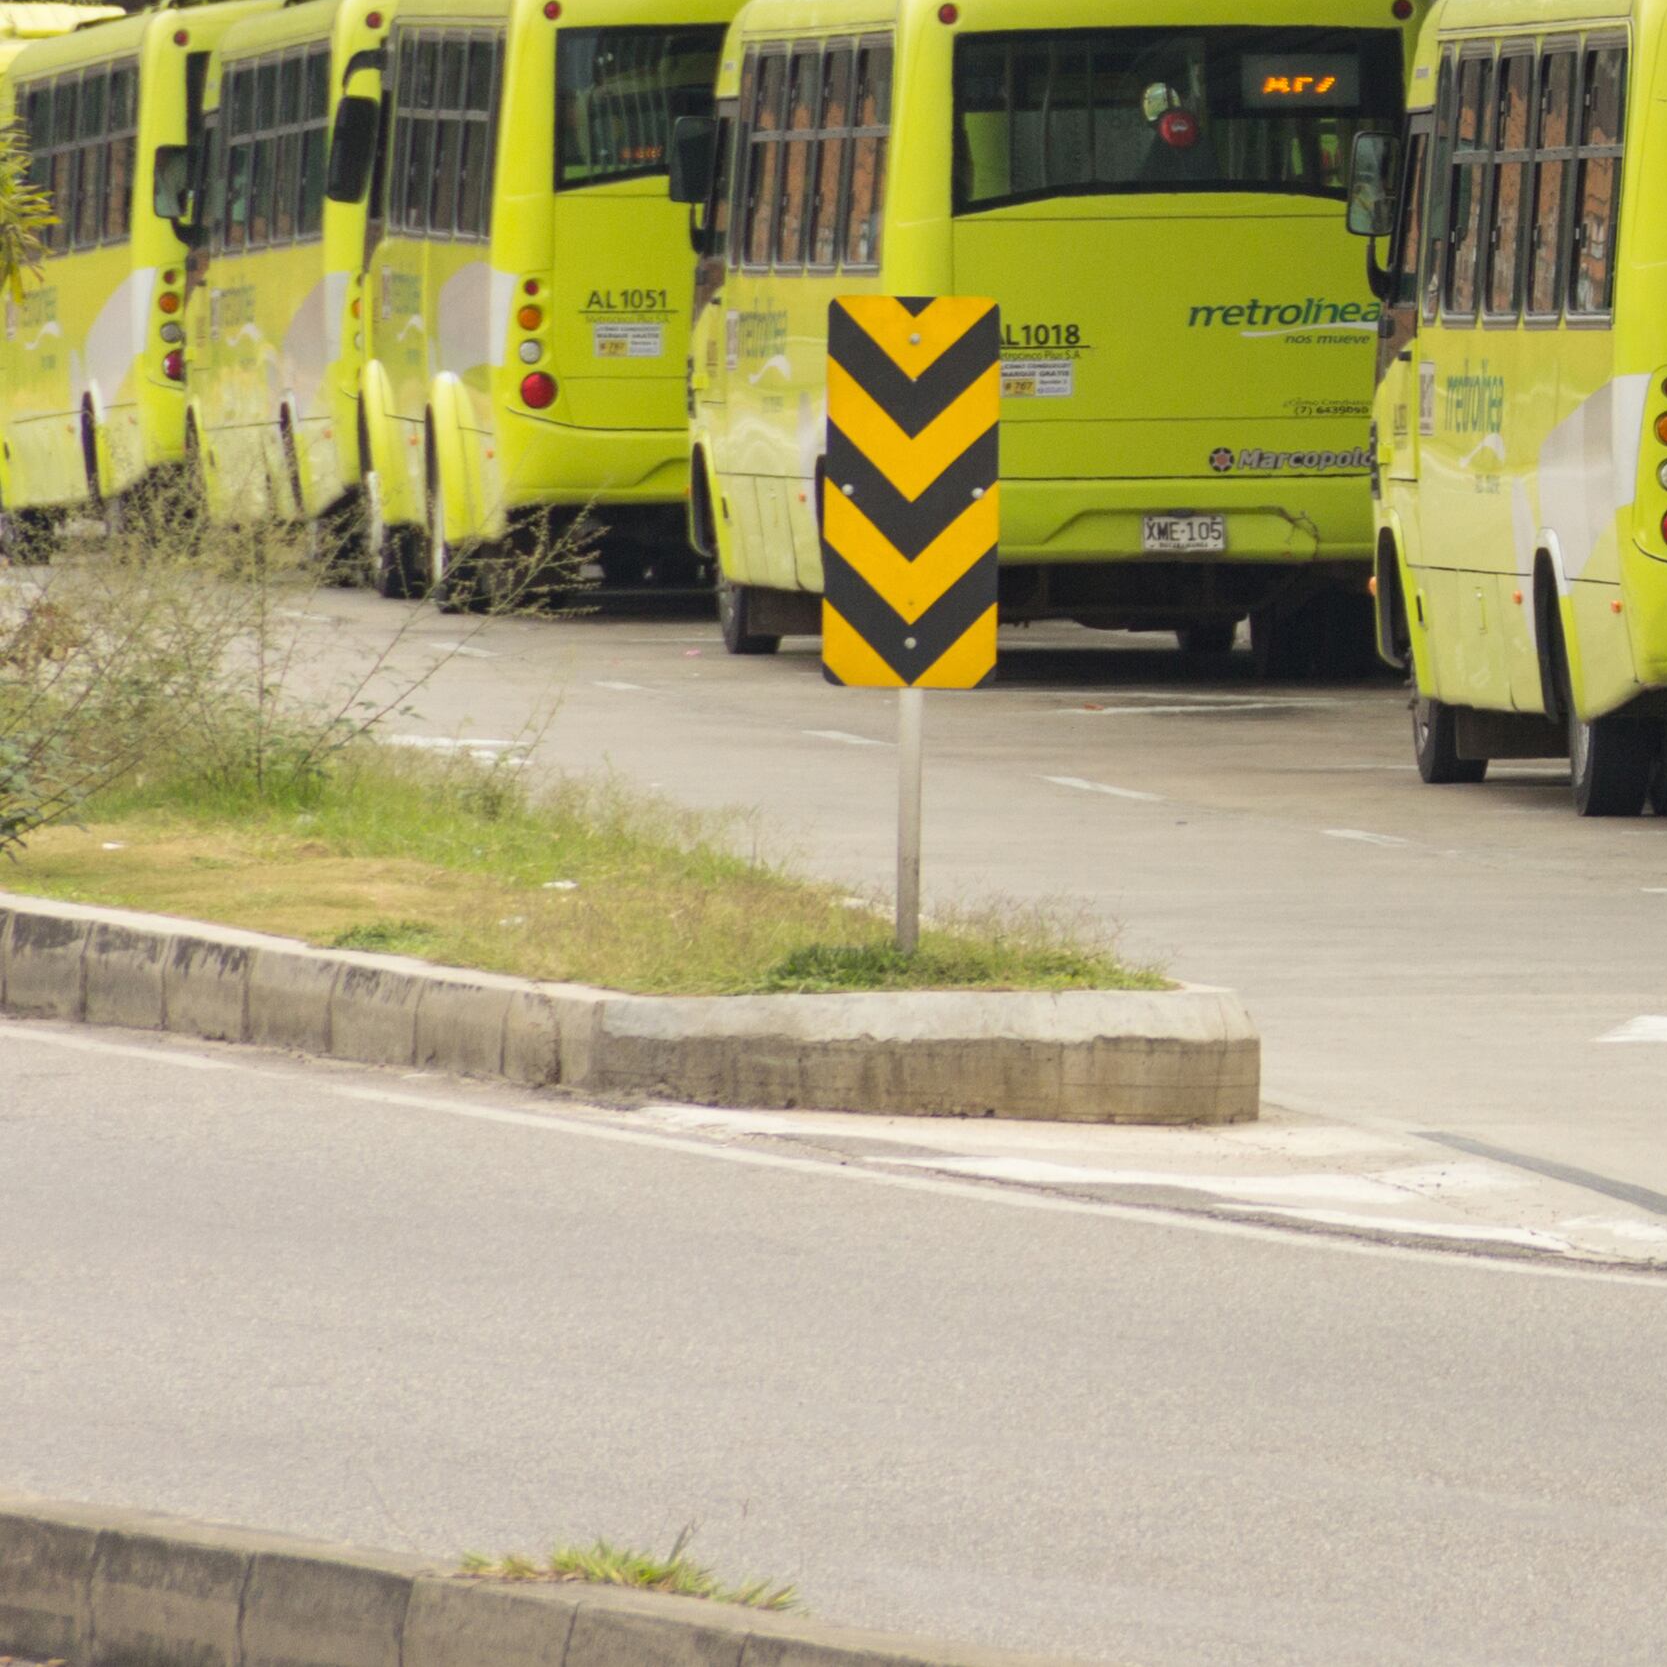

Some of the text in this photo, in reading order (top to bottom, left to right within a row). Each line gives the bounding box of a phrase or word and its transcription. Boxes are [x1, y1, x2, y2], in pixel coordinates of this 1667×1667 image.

[1189, 298, 1381, 327] metrolínea
[1000, 323, 1081, 345] L1018
[1285, 334, 1370, 344] nos mueve
